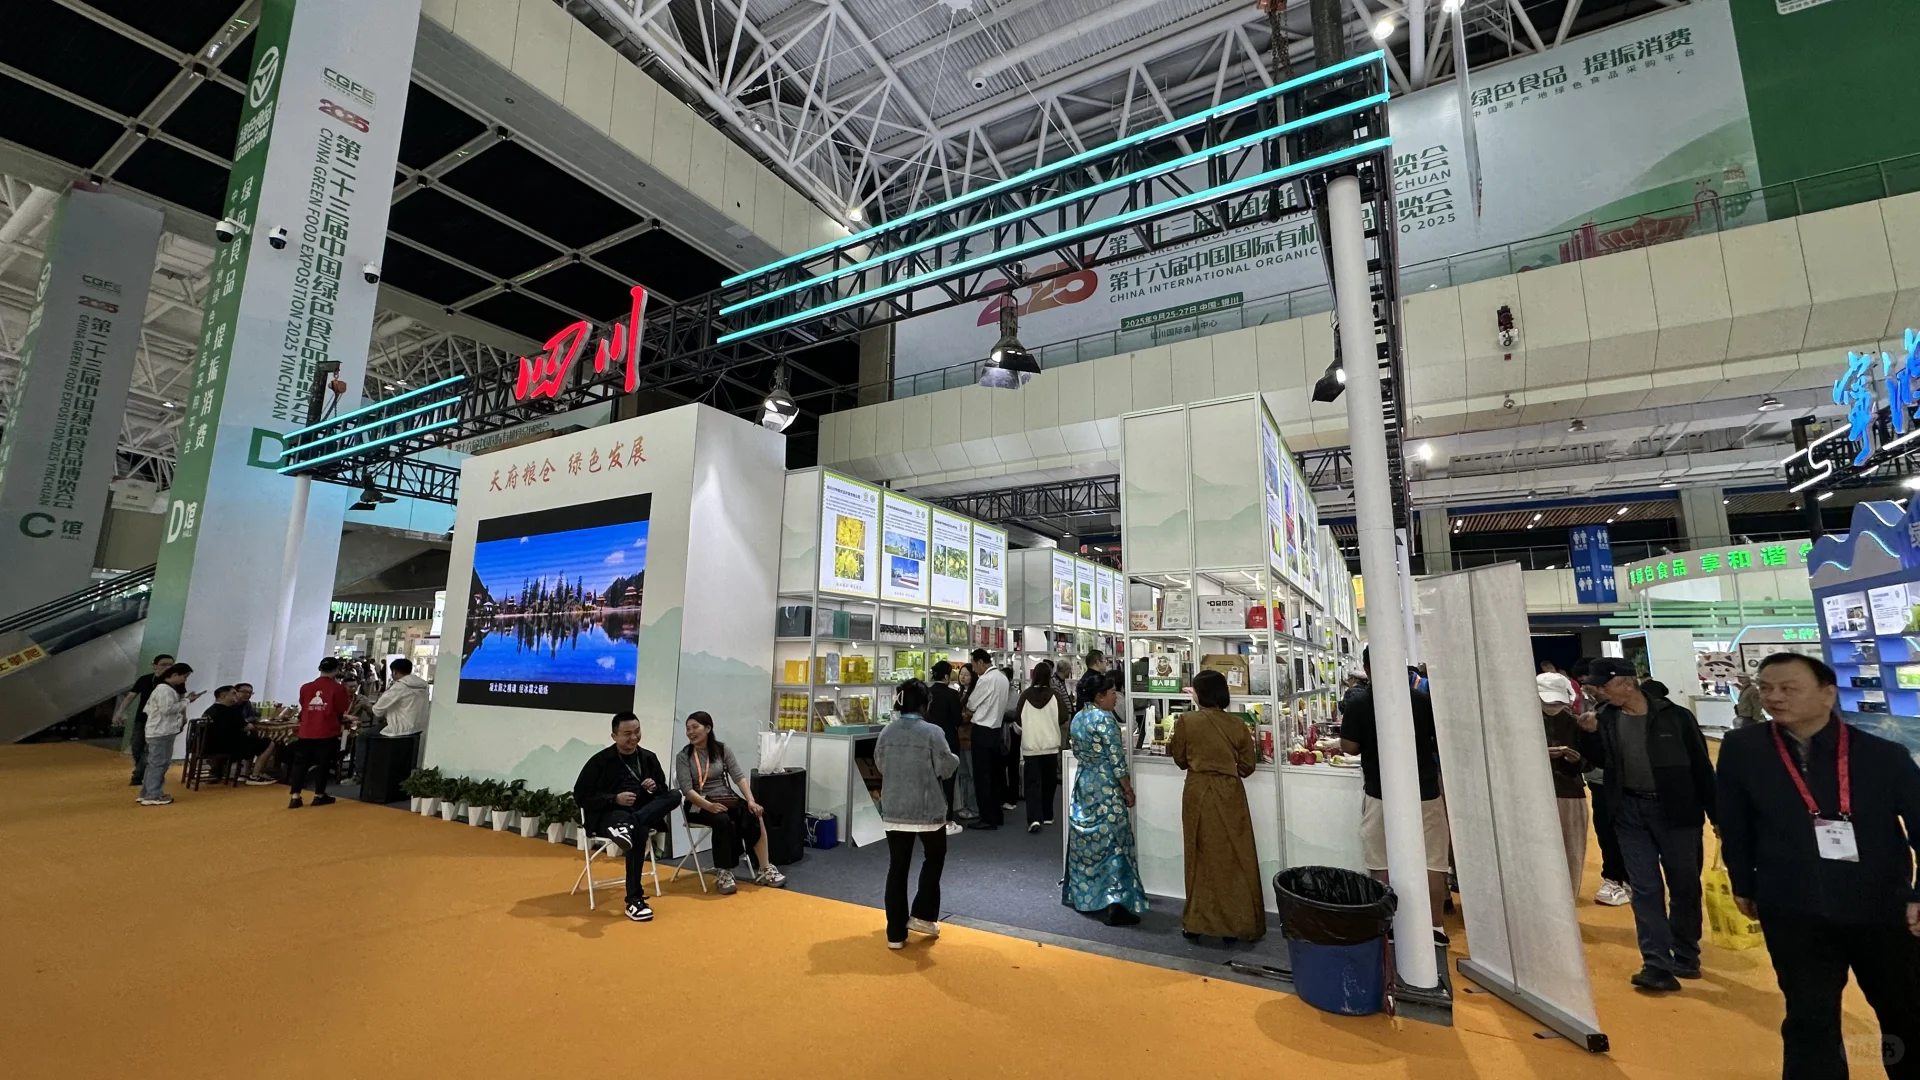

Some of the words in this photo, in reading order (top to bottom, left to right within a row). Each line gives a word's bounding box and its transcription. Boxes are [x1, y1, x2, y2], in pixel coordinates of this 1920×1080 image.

[323, 67, 375, 100] CGFE
[1471, 65, 1567, 106] 绿色食品
[1583, 28, 1693, 76] 提振消费
[1473, 48, 1694, 118] 中国源产地绿色食品采购平台
[318, 98, 370, 133] 2025
[316, 128, 333, 164] CHINA
[307, 166, 327, 208] GREEN
[303, 207, 321, 243] FOOD
[1110, 284, 1146, 303] CHINA
[1149, 263, 1251, 295] INTERNATIONAL
[1255, 247, 1318, 269] ORGANIC
[1417, 213, 1456, 230] 2025
[289, 244, 314, 319] EXPOSITION
[74, 314, 90, 339] CHINA
[284, 319, 300, 351] 2025
[1125, 305, 1197, 327] 2025年9月25-27日
[70, 339, 85, 369] GREEN
[516, 286, 647, 399] 四川
[64, 368, 78, 391] FOOD
[194, 322, 227, 450] 提振消费
[272, 353, 297, 421] YINCHUAN
[53, 391, 73, 441] EXPOSITION
[247, 427, 288, 469] D
[489, 459, 556, 492] 天府粮仓
[568, 436, 647, 474] 绿色发展
[19, 512, 56, 538] C
[61, 519, 84, 535] 馆
[166, 500, 184, 543] D
[184, 501, 198, 529] 馆
